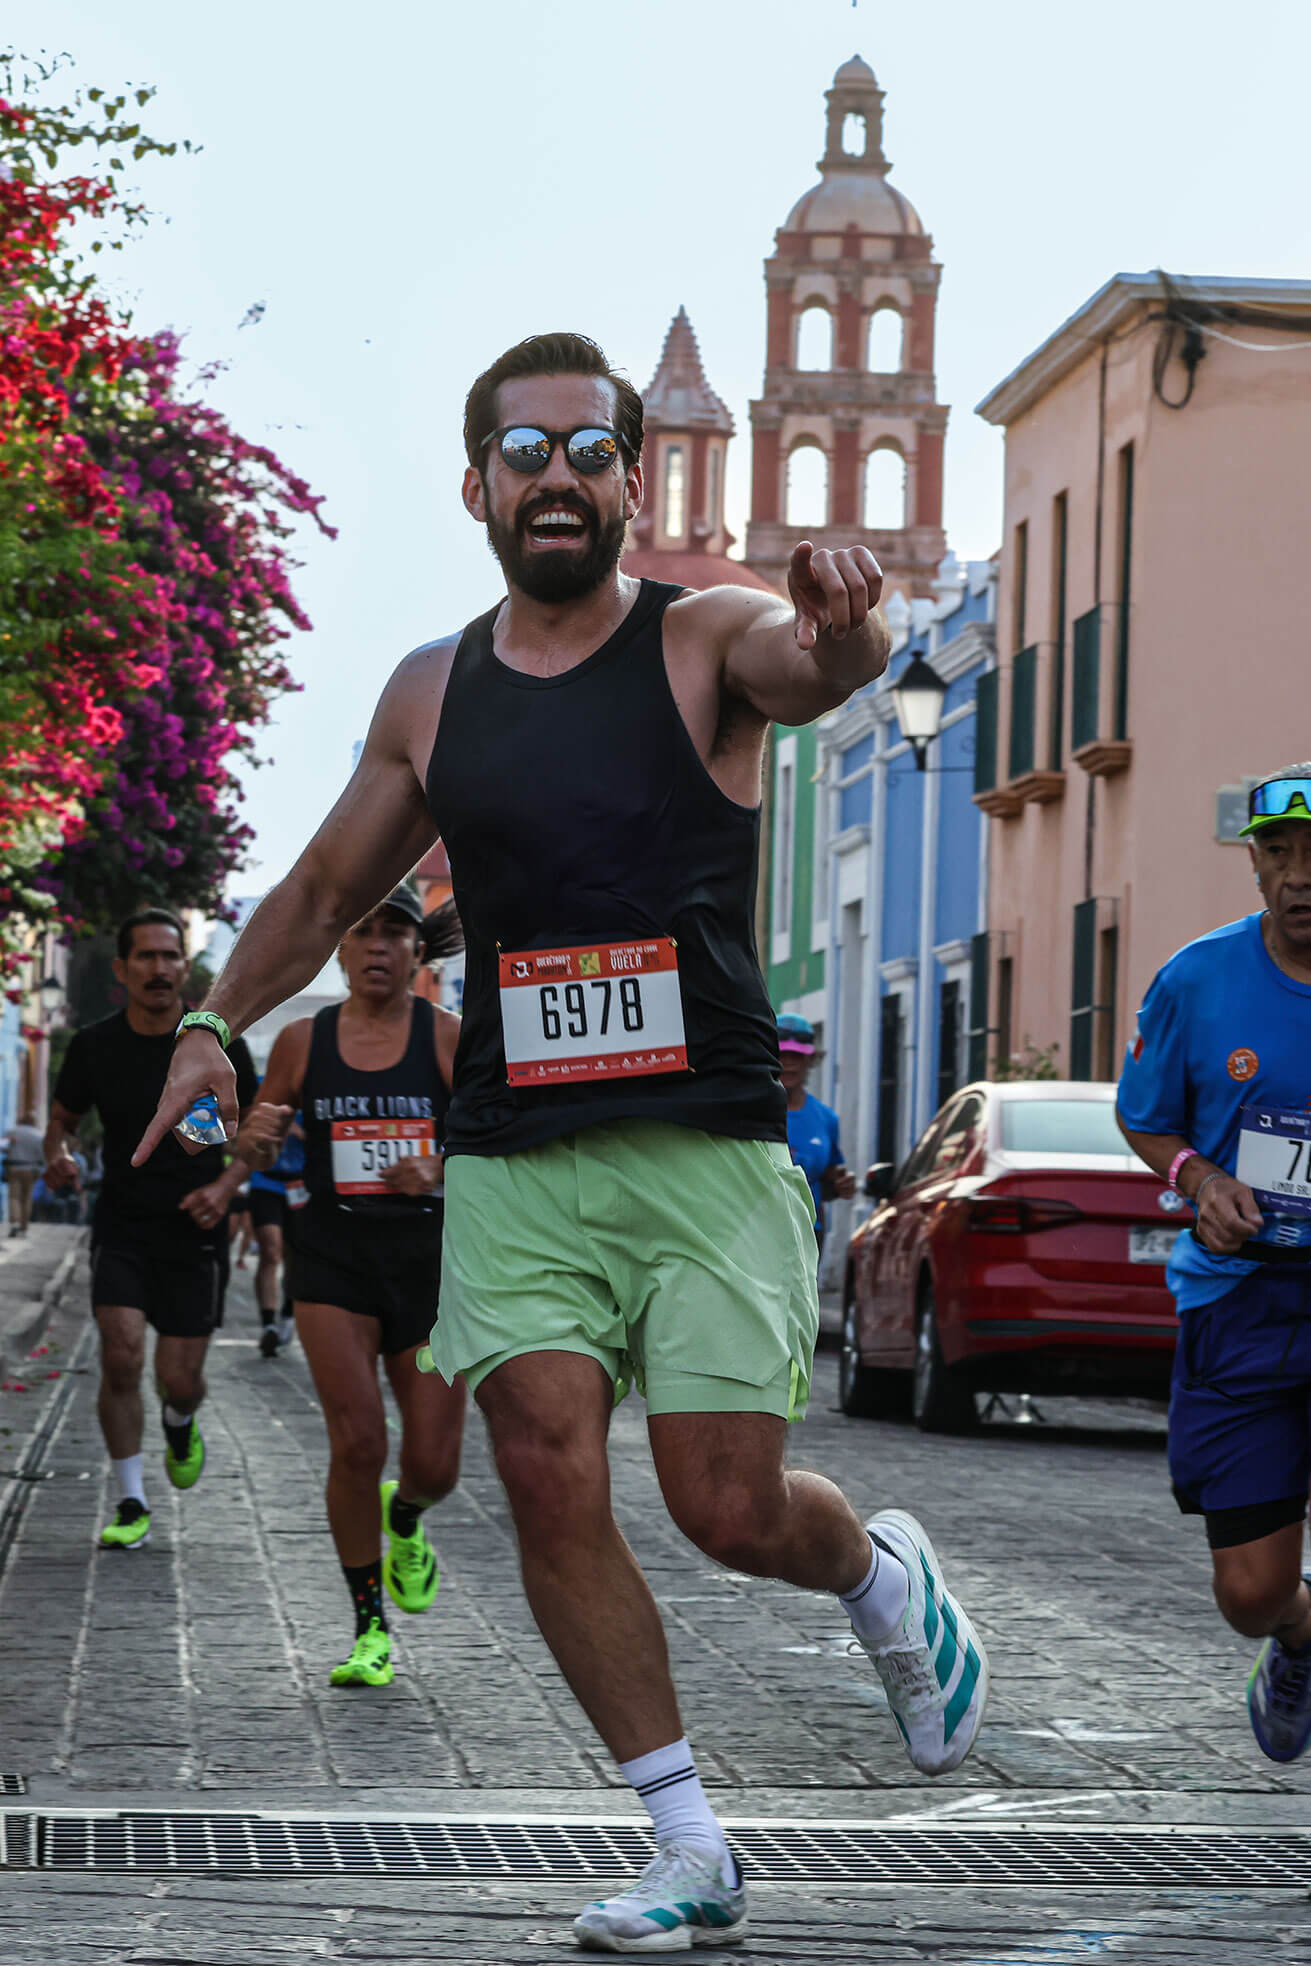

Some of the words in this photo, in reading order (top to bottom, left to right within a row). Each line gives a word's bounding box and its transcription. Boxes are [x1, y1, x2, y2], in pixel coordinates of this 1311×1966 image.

[540, 977, 643, 1040] 6978
[315, 1096, 371, 1120] BLACK
[376, 1096, 433, 1118] LIONS
